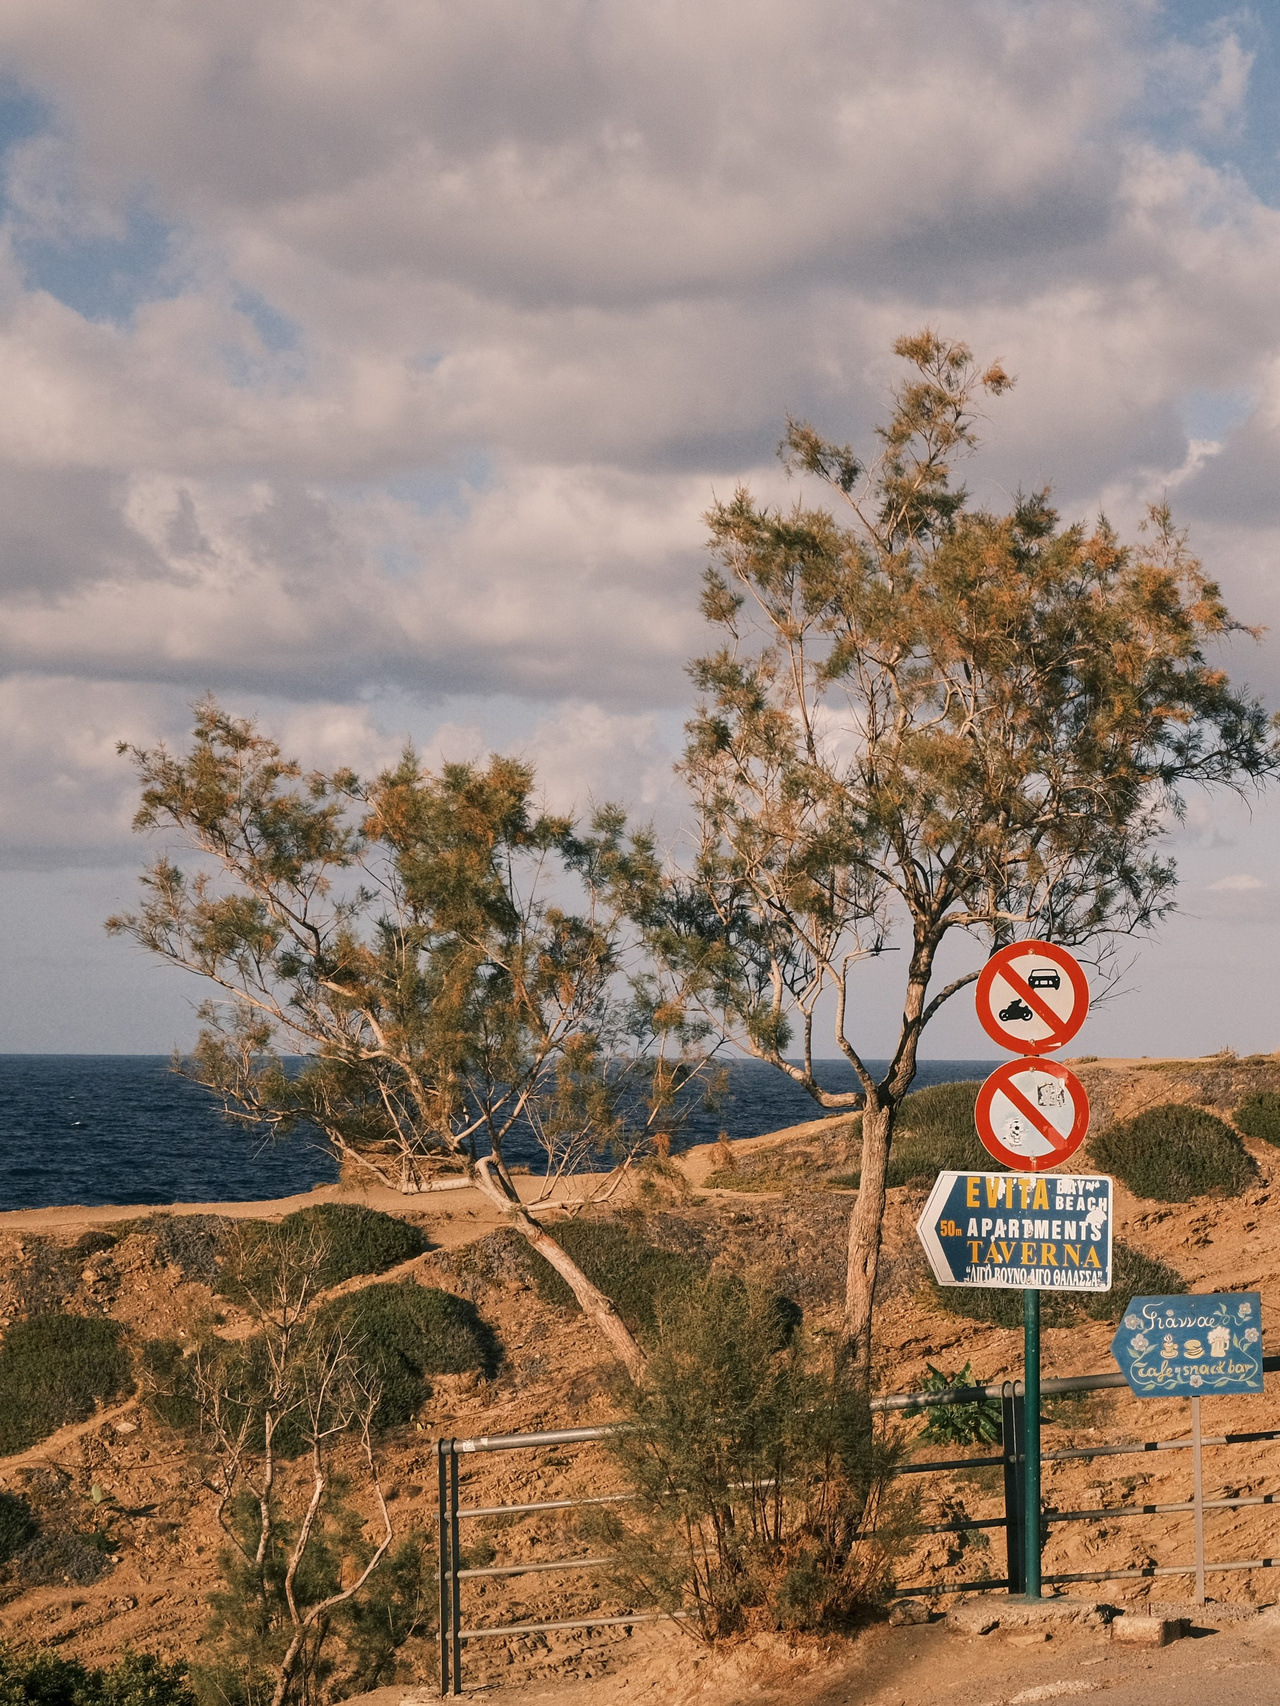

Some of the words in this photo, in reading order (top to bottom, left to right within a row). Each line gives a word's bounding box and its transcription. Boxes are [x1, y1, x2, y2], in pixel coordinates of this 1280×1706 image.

[966, 1177, 1050, 1210] EVITA
[1056, 1179, 1085, 1195] BAY
[1055, 1196, 1108, 1212] BEACH
[940, 1220, 962, 1237] 50m
[967, 1217, 1102, 1241] APARTMENTS
[967, 1240, 1102, 1268] TAVERNA
[1183, 1361, 1226, 1375] snack
[1228, 1359, 1254, 1374] bar
